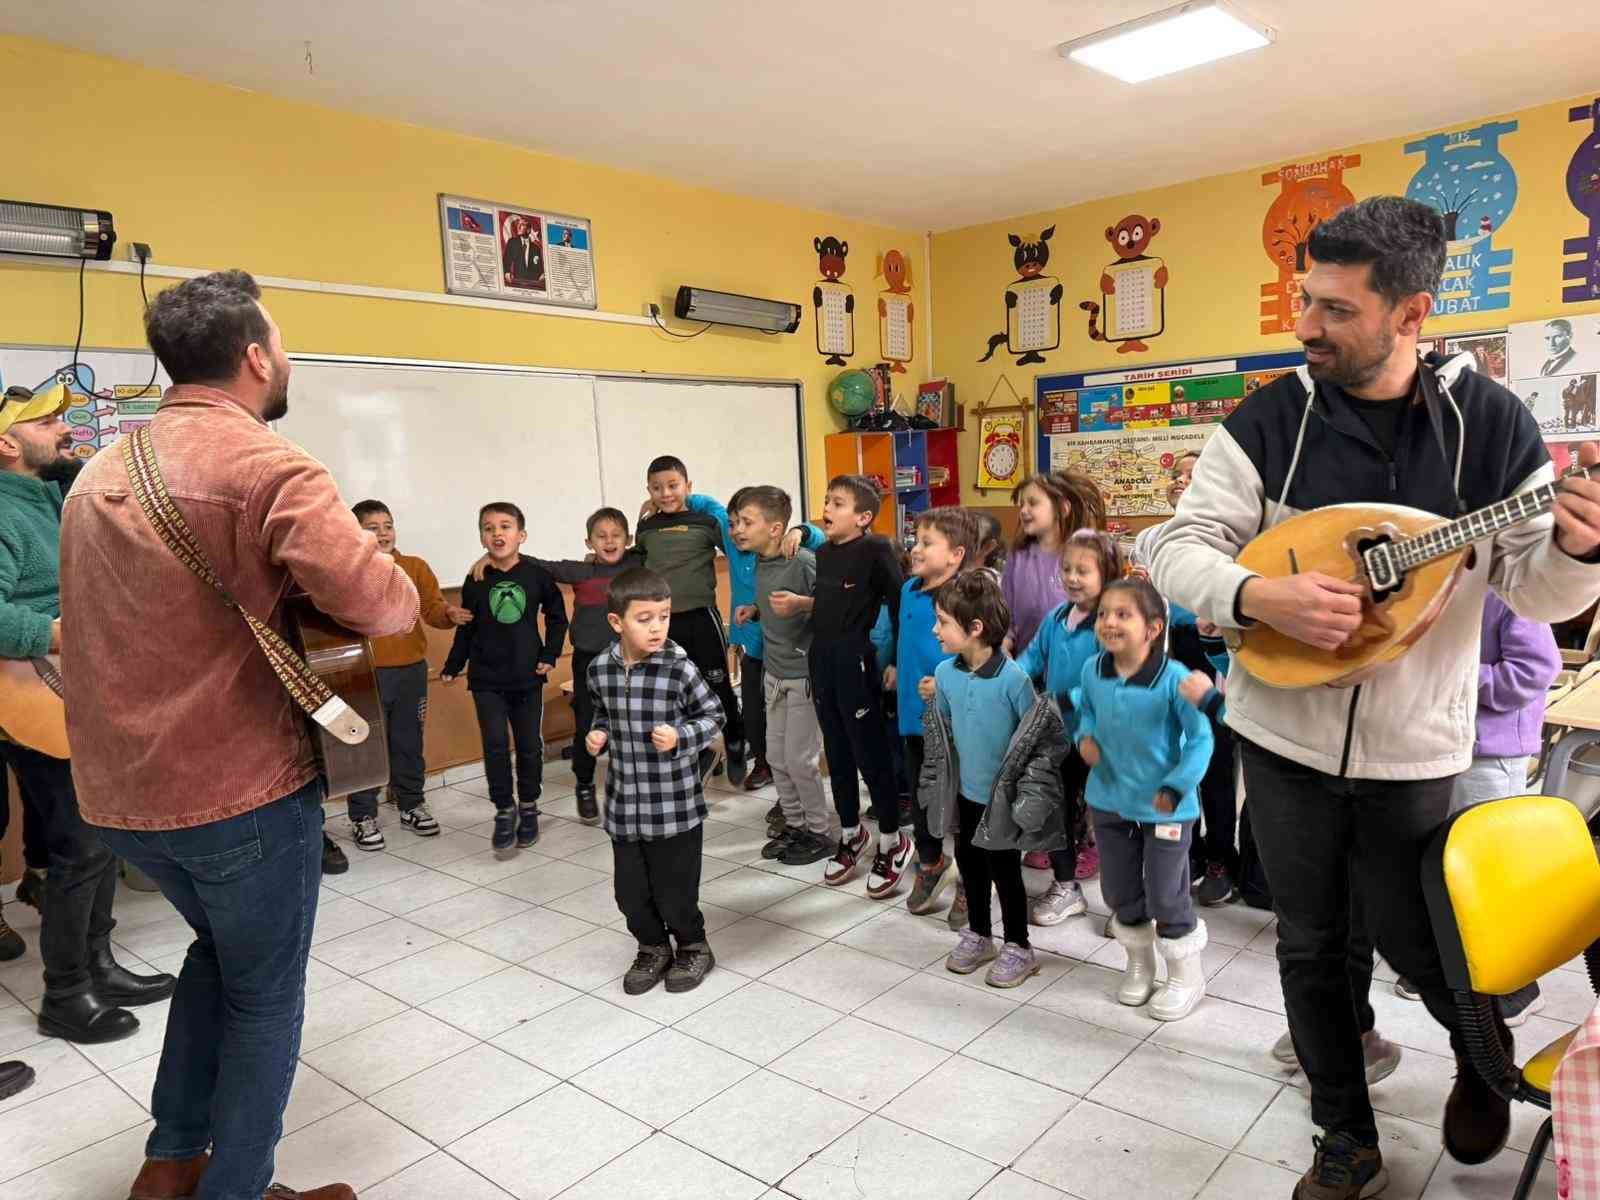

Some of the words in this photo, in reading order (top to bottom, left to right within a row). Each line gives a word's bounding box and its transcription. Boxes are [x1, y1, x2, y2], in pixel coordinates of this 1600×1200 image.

[1443, 252, 1483, 271] ALIK
[1441, 275, 1476, 292] CAK
[1433, 295, 1481, 314] UBAT
[1123, 370, 1154, 381] TARİH
